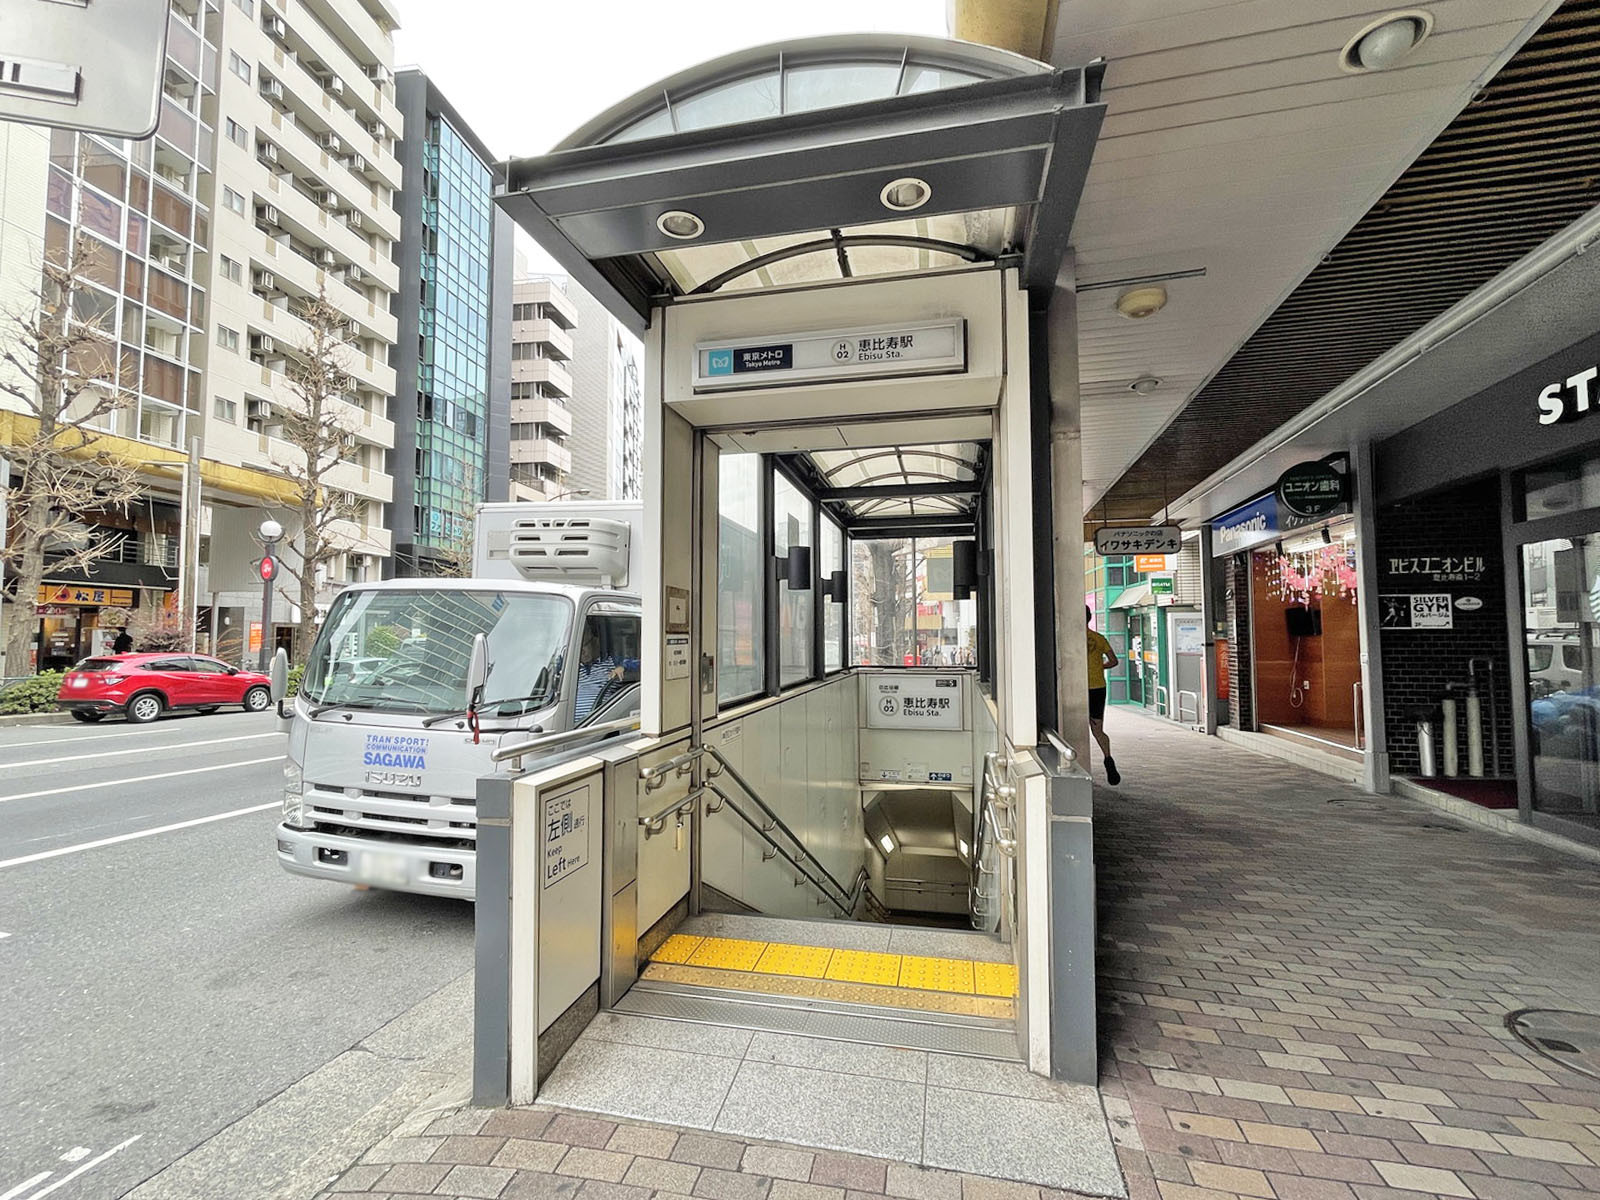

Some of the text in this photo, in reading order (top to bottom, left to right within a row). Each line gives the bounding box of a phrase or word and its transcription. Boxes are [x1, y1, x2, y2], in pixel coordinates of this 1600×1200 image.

[839, 343, 847, 351] H
[858, 335, 914, 352] 恵比寿駅
[743, 350, 783, 361] 東京メトロ
[836, 351, 849, 360] 02
[858, 350, 904, 361] Ebisu Sta.
[1538, 366, 1600, 425] ST
[1285, 480, 1340, 493] ユニオン歯科
[1114, 529, 1163, 537] パナソニックの店
[1220, 511, 1267, 543] Panasonic
[1100, 538, 1178, 551] イワサキデンキ
[75, 590, 105, 602] 松屋
[1413, 596, 1449, 604] SILVER
[1413, 603, 1450, 613] GYM
[903, 697, 950, 709] 恵比寿駅
[903, 708, 942, 717] Ebisu Sta.
[366, 743, 426, 754] COMMUNICATION
[364, 751, 426, 769] SAGAWA
[365, 771, 422, 787] ISUZU
[548, 799, 571, 816] ここでは
[547, 845, 562, 858] Keep
[547, 856, 580, 879] Left Here
